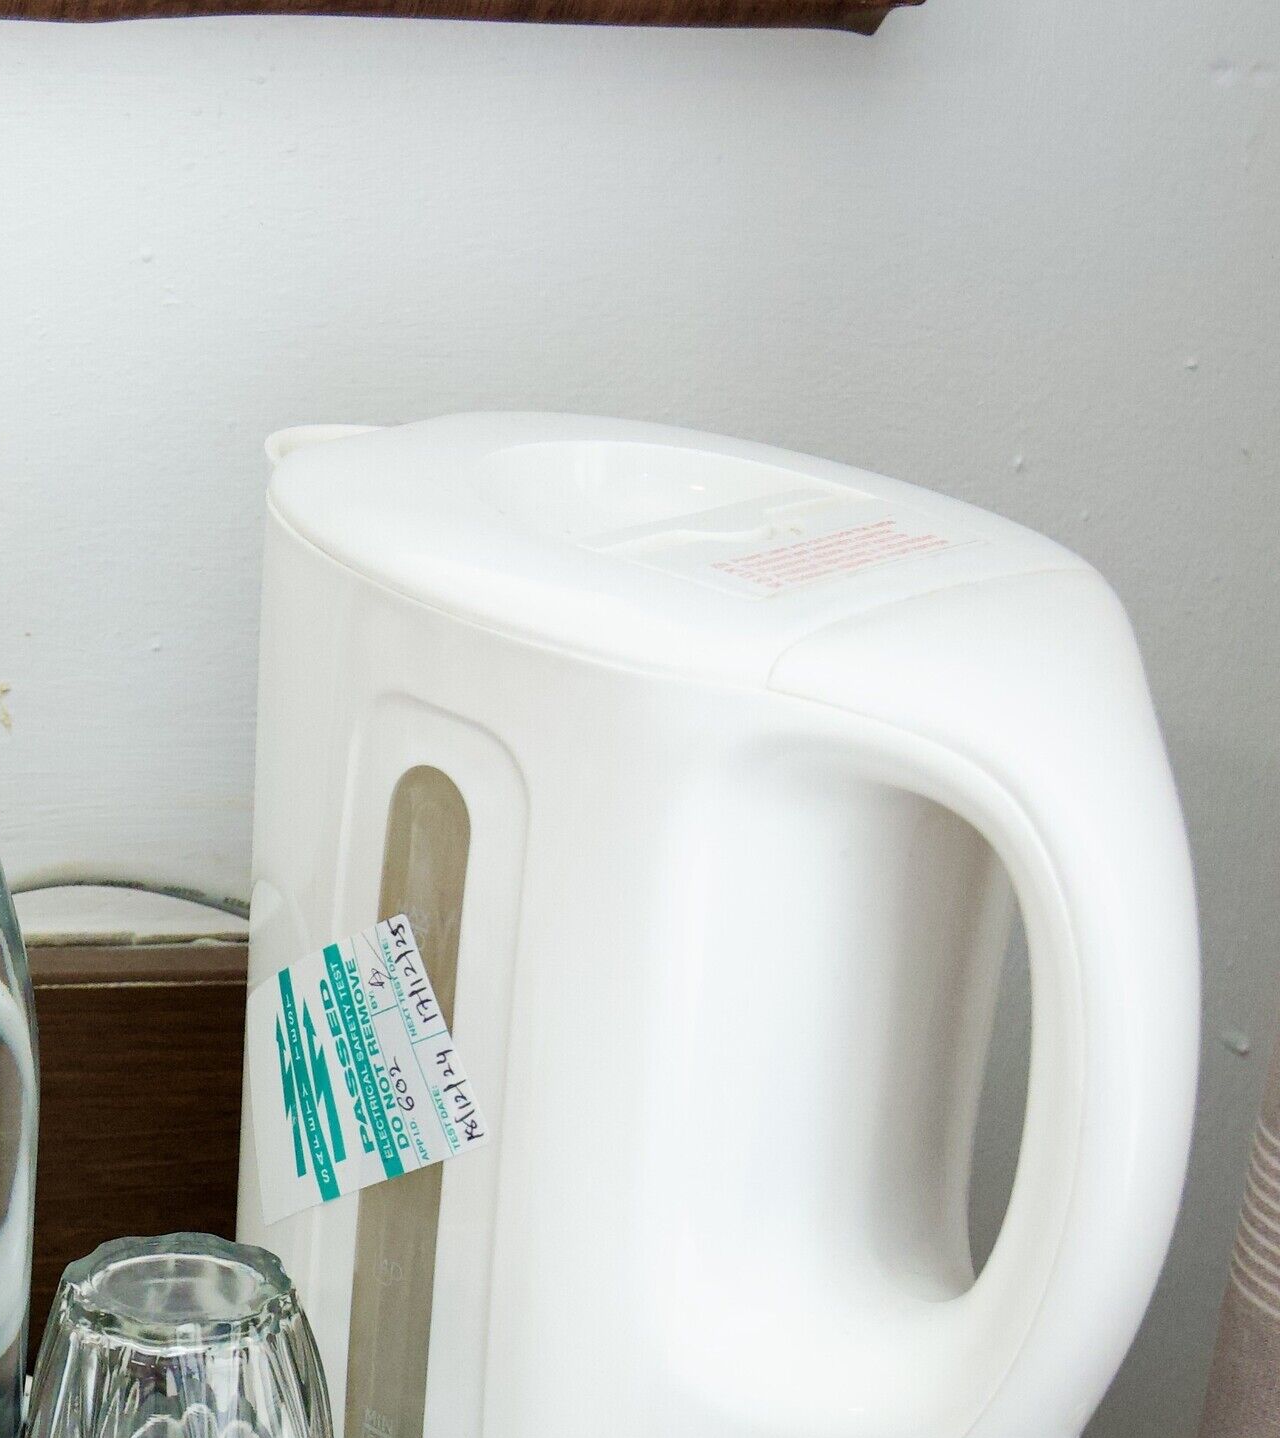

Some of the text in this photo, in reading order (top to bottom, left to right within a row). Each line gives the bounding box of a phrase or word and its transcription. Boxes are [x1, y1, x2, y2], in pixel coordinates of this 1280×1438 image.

[344, 956, 380, 1057] REMOVE
[403, 1006, 418, 1038] NEXT
[283, 994, 331, 1184] SAFETY TEST
[319, 978, 375, 1154] PASSED
[329, 961, 395, 1160] ELECTRICAL SAFETY TEST
[373, 1062, 396, 1111] NOT
[389, 1055, 415, 1112] 602
[390, 1116, 410, 1150] DO
[443, 1118, 461, 1152] TEST
